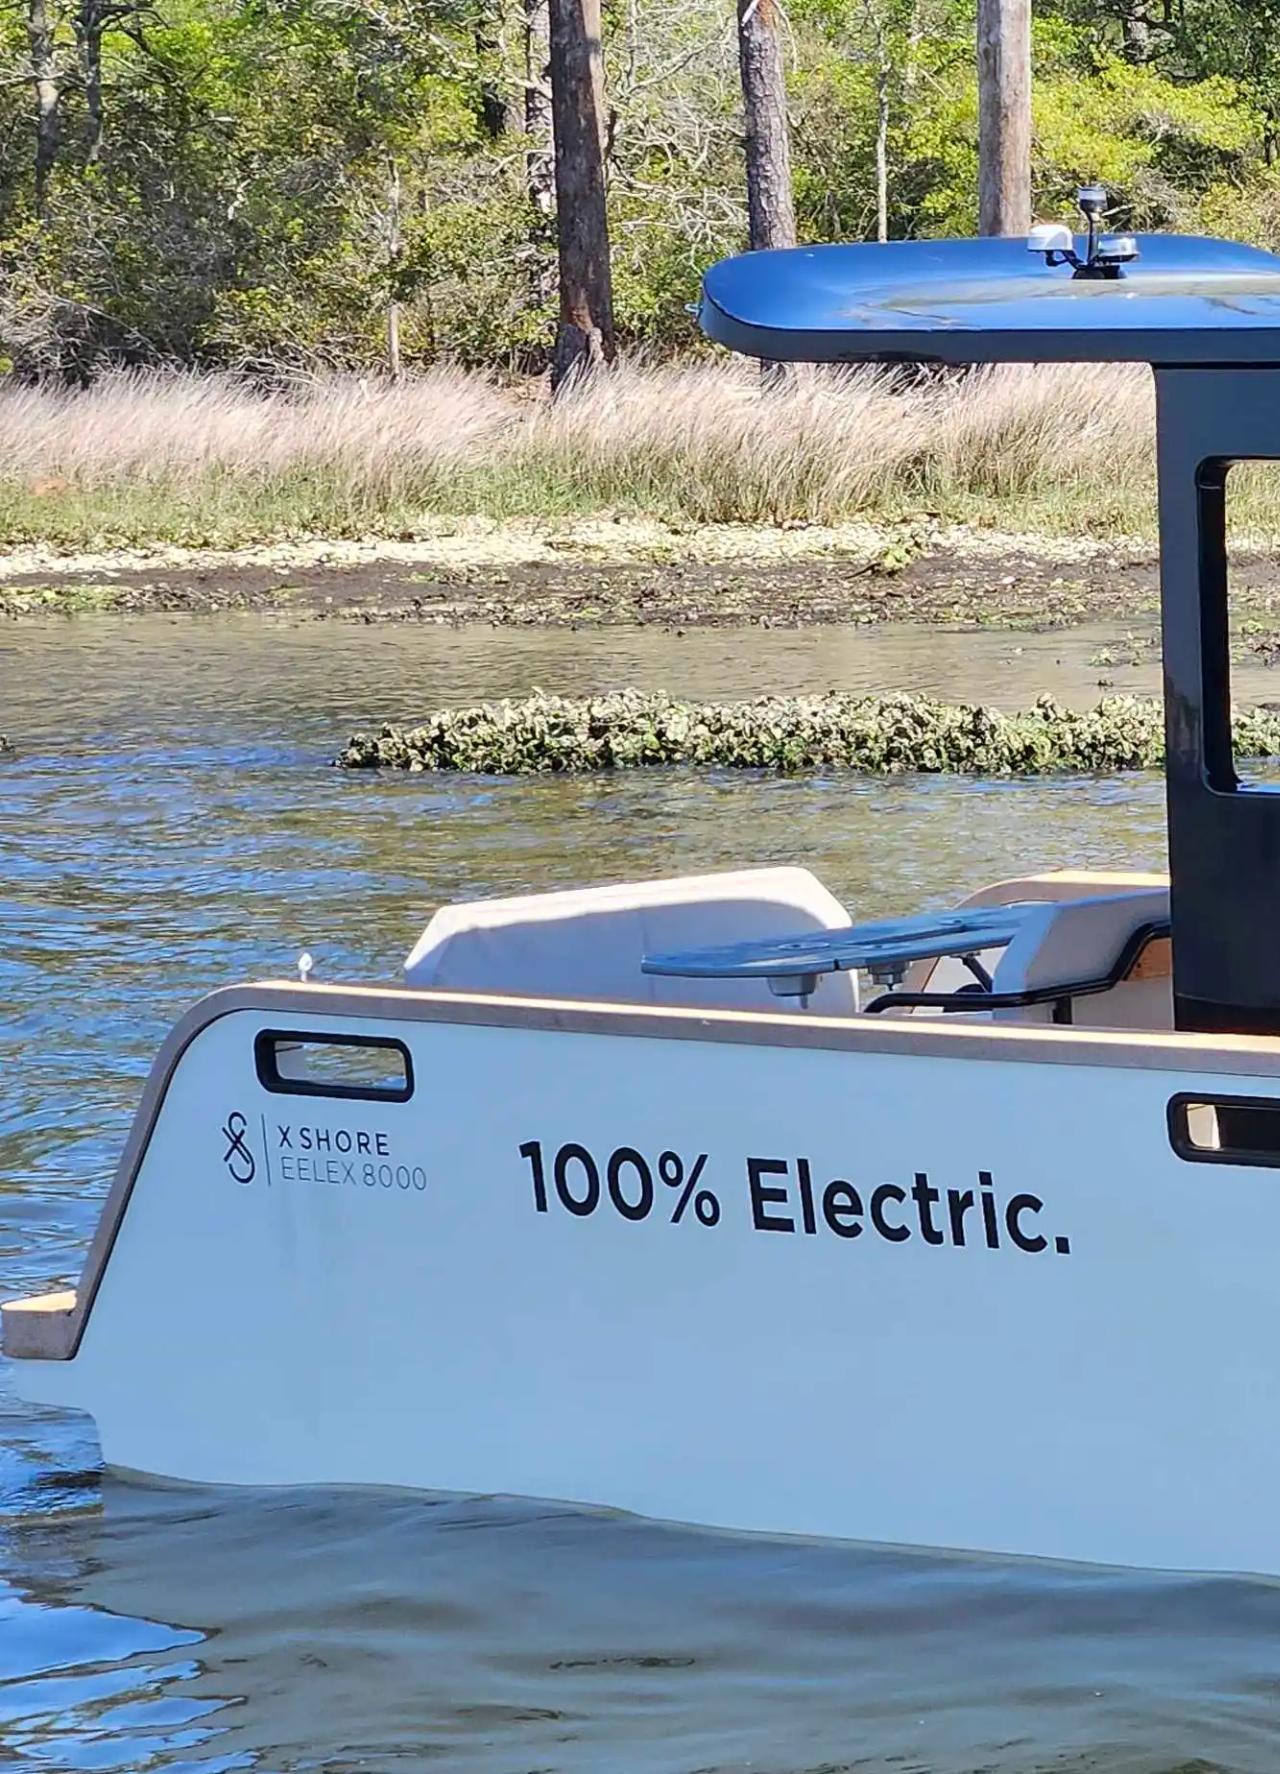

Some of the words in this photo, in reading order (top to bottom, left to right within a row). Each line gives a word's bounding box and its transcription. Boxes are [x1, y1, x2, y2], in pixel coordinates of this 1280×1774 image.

[277, 1125, 293, 1149] X
[299, 1127, 390, 1156] SHORE
[281, 1156, 357, 1186] EELEX
[362, 1163, 428, 1191] 8000
[518, 1139, 721, 1228] 100%
[747, 1157, 1071, 1255] Electric.
